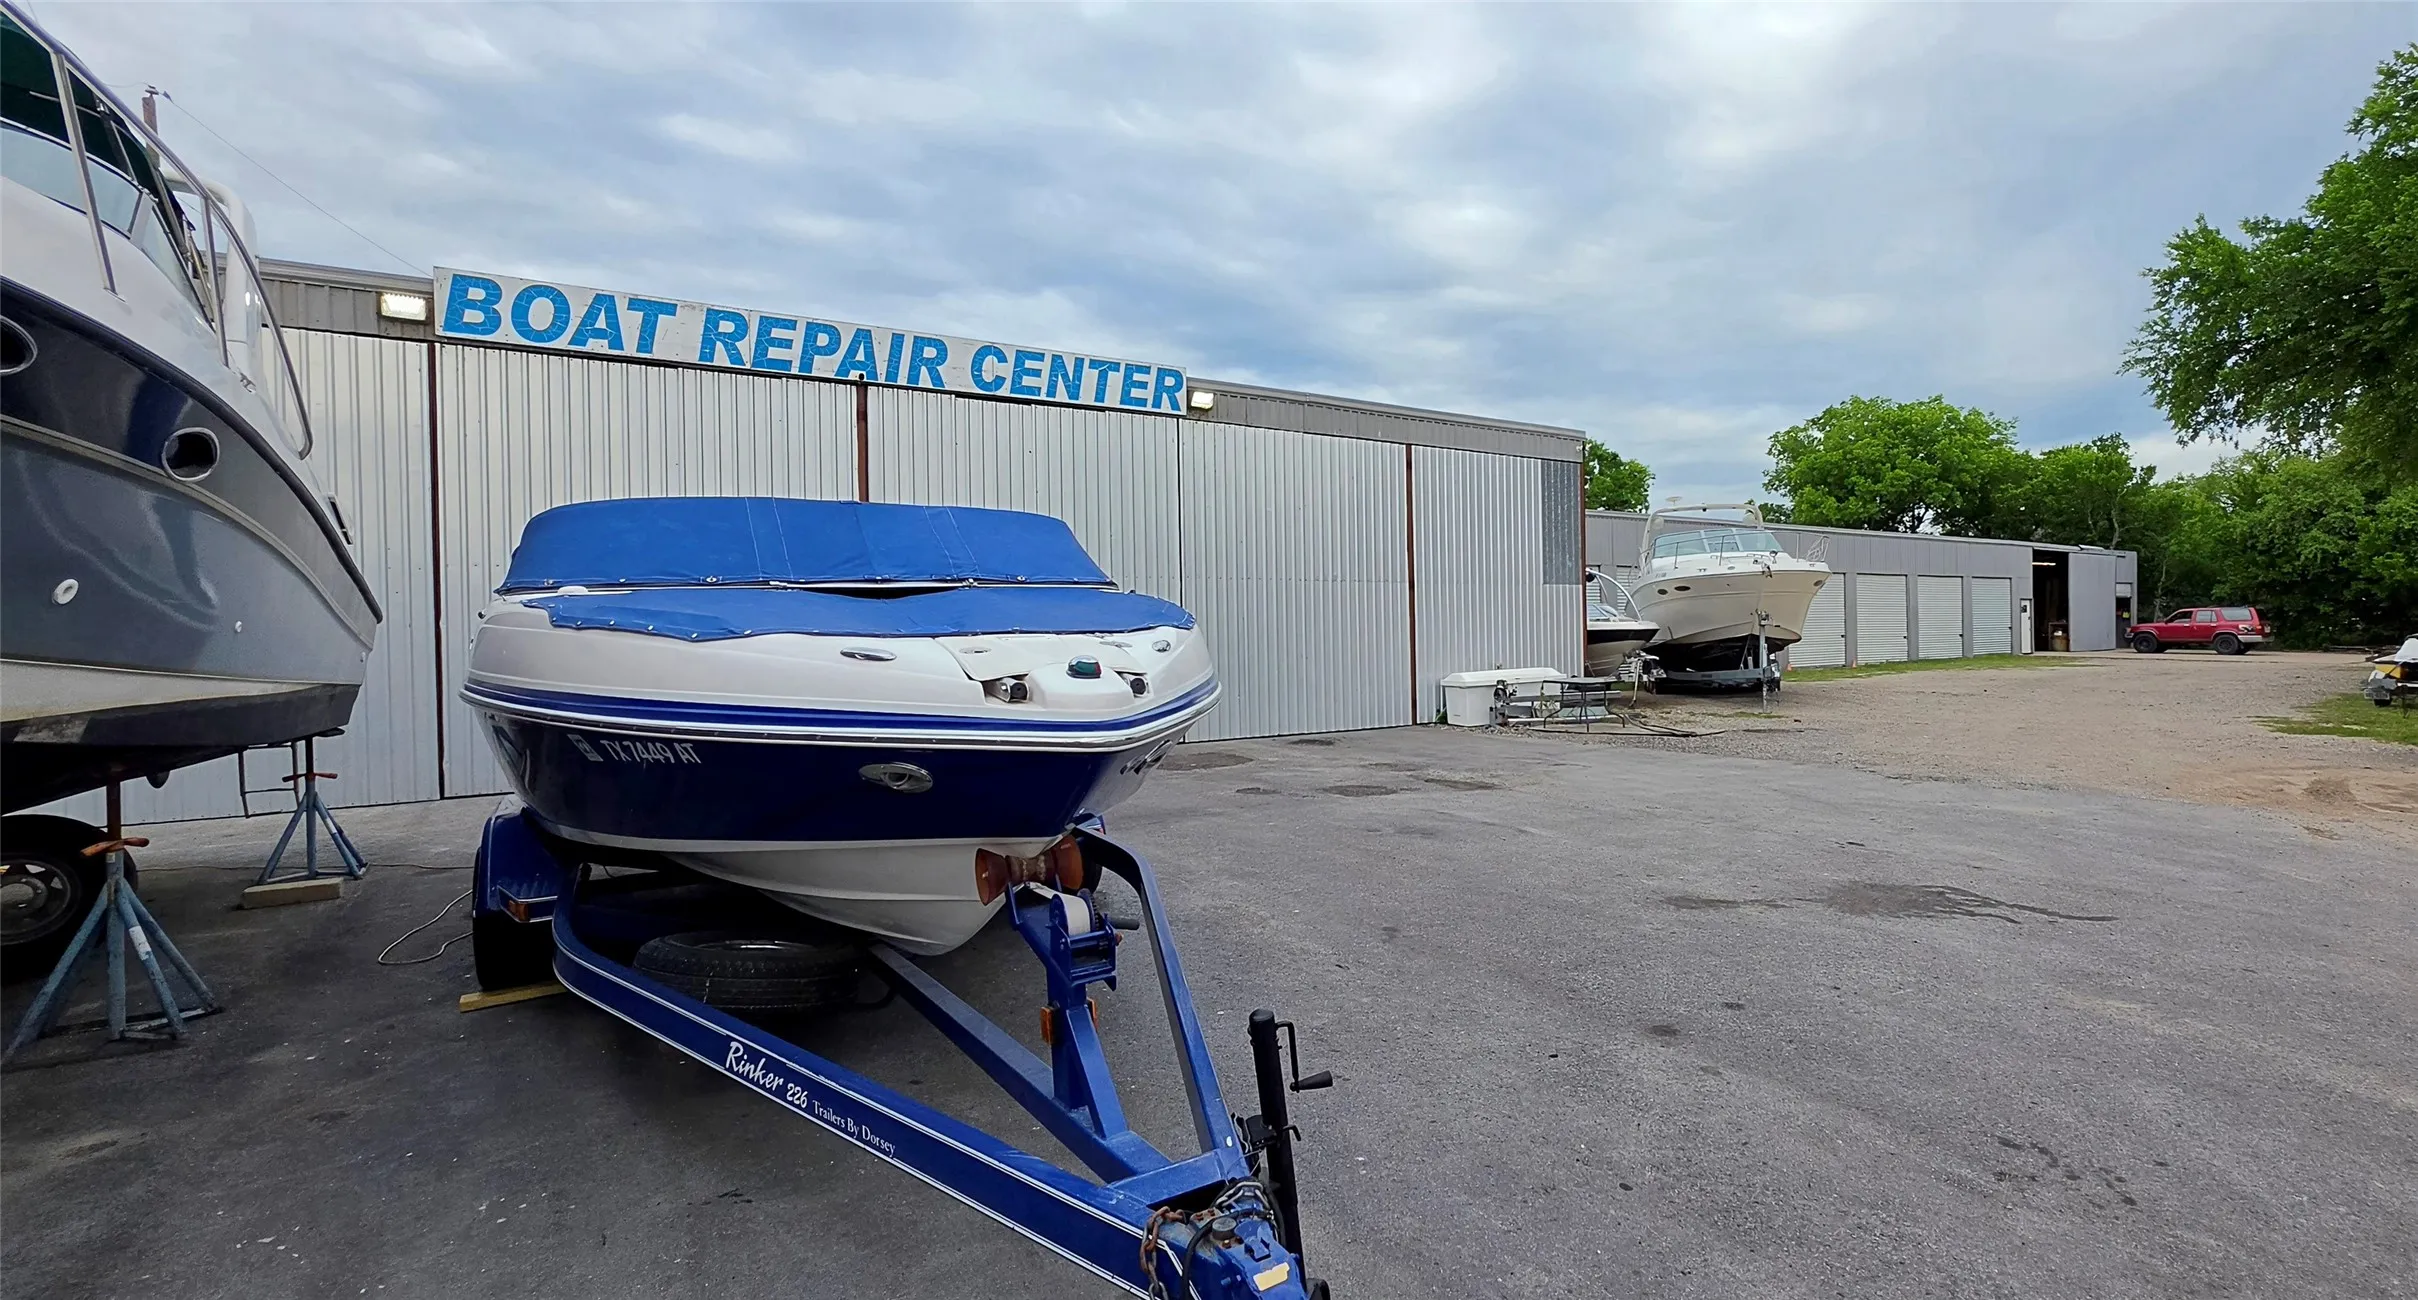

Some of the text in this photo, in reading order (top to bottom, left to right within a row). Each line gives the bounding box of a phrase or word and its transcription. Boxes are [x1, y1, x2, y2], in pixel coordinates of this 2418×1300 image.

[443, 274, 1184, 412] BOAT REPAIR CENTER
[673, 742, 702, 763] AT
[725, 1041, 896, 1158] Rinker 226 Trailers By Dorsey
